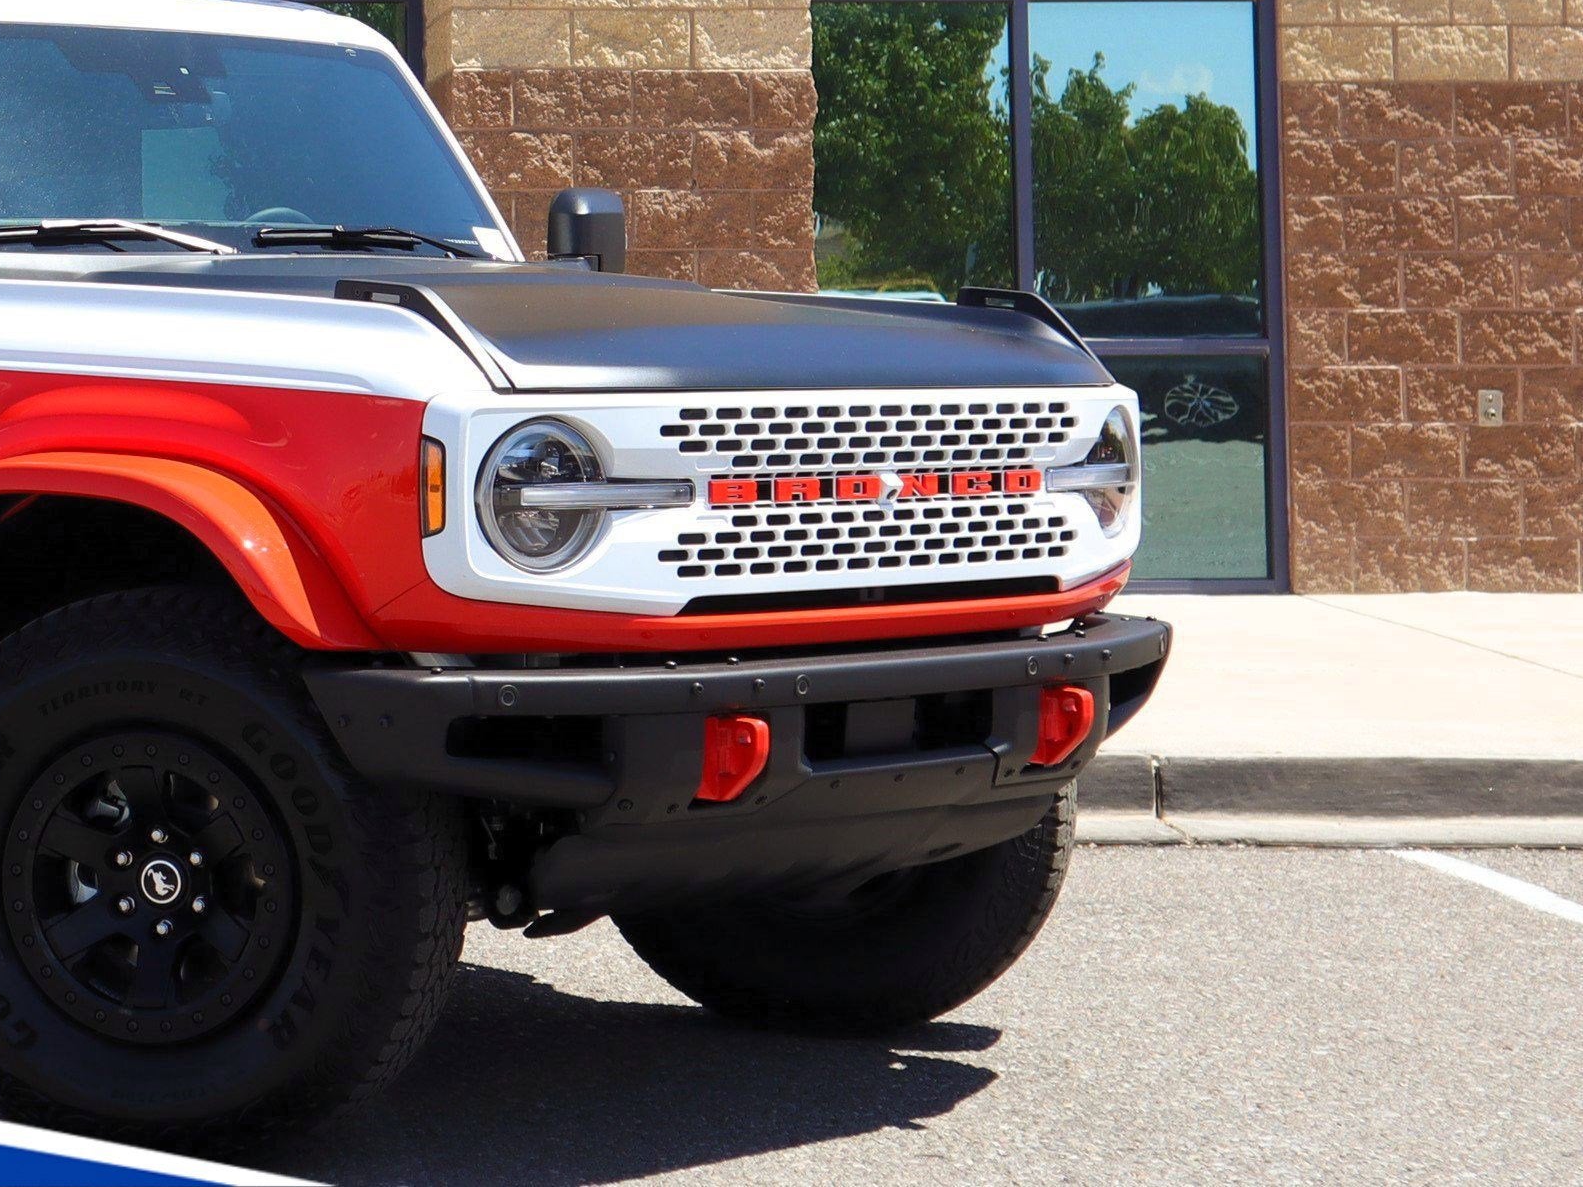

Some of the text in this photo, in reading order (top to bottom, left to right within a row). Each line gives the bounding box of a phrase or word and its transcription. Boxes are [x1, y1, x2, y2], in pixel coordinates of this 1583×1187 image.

[708, 468, 1042, 505] BRONCO
[36, 679, 210, 718] TERRITORY RT
